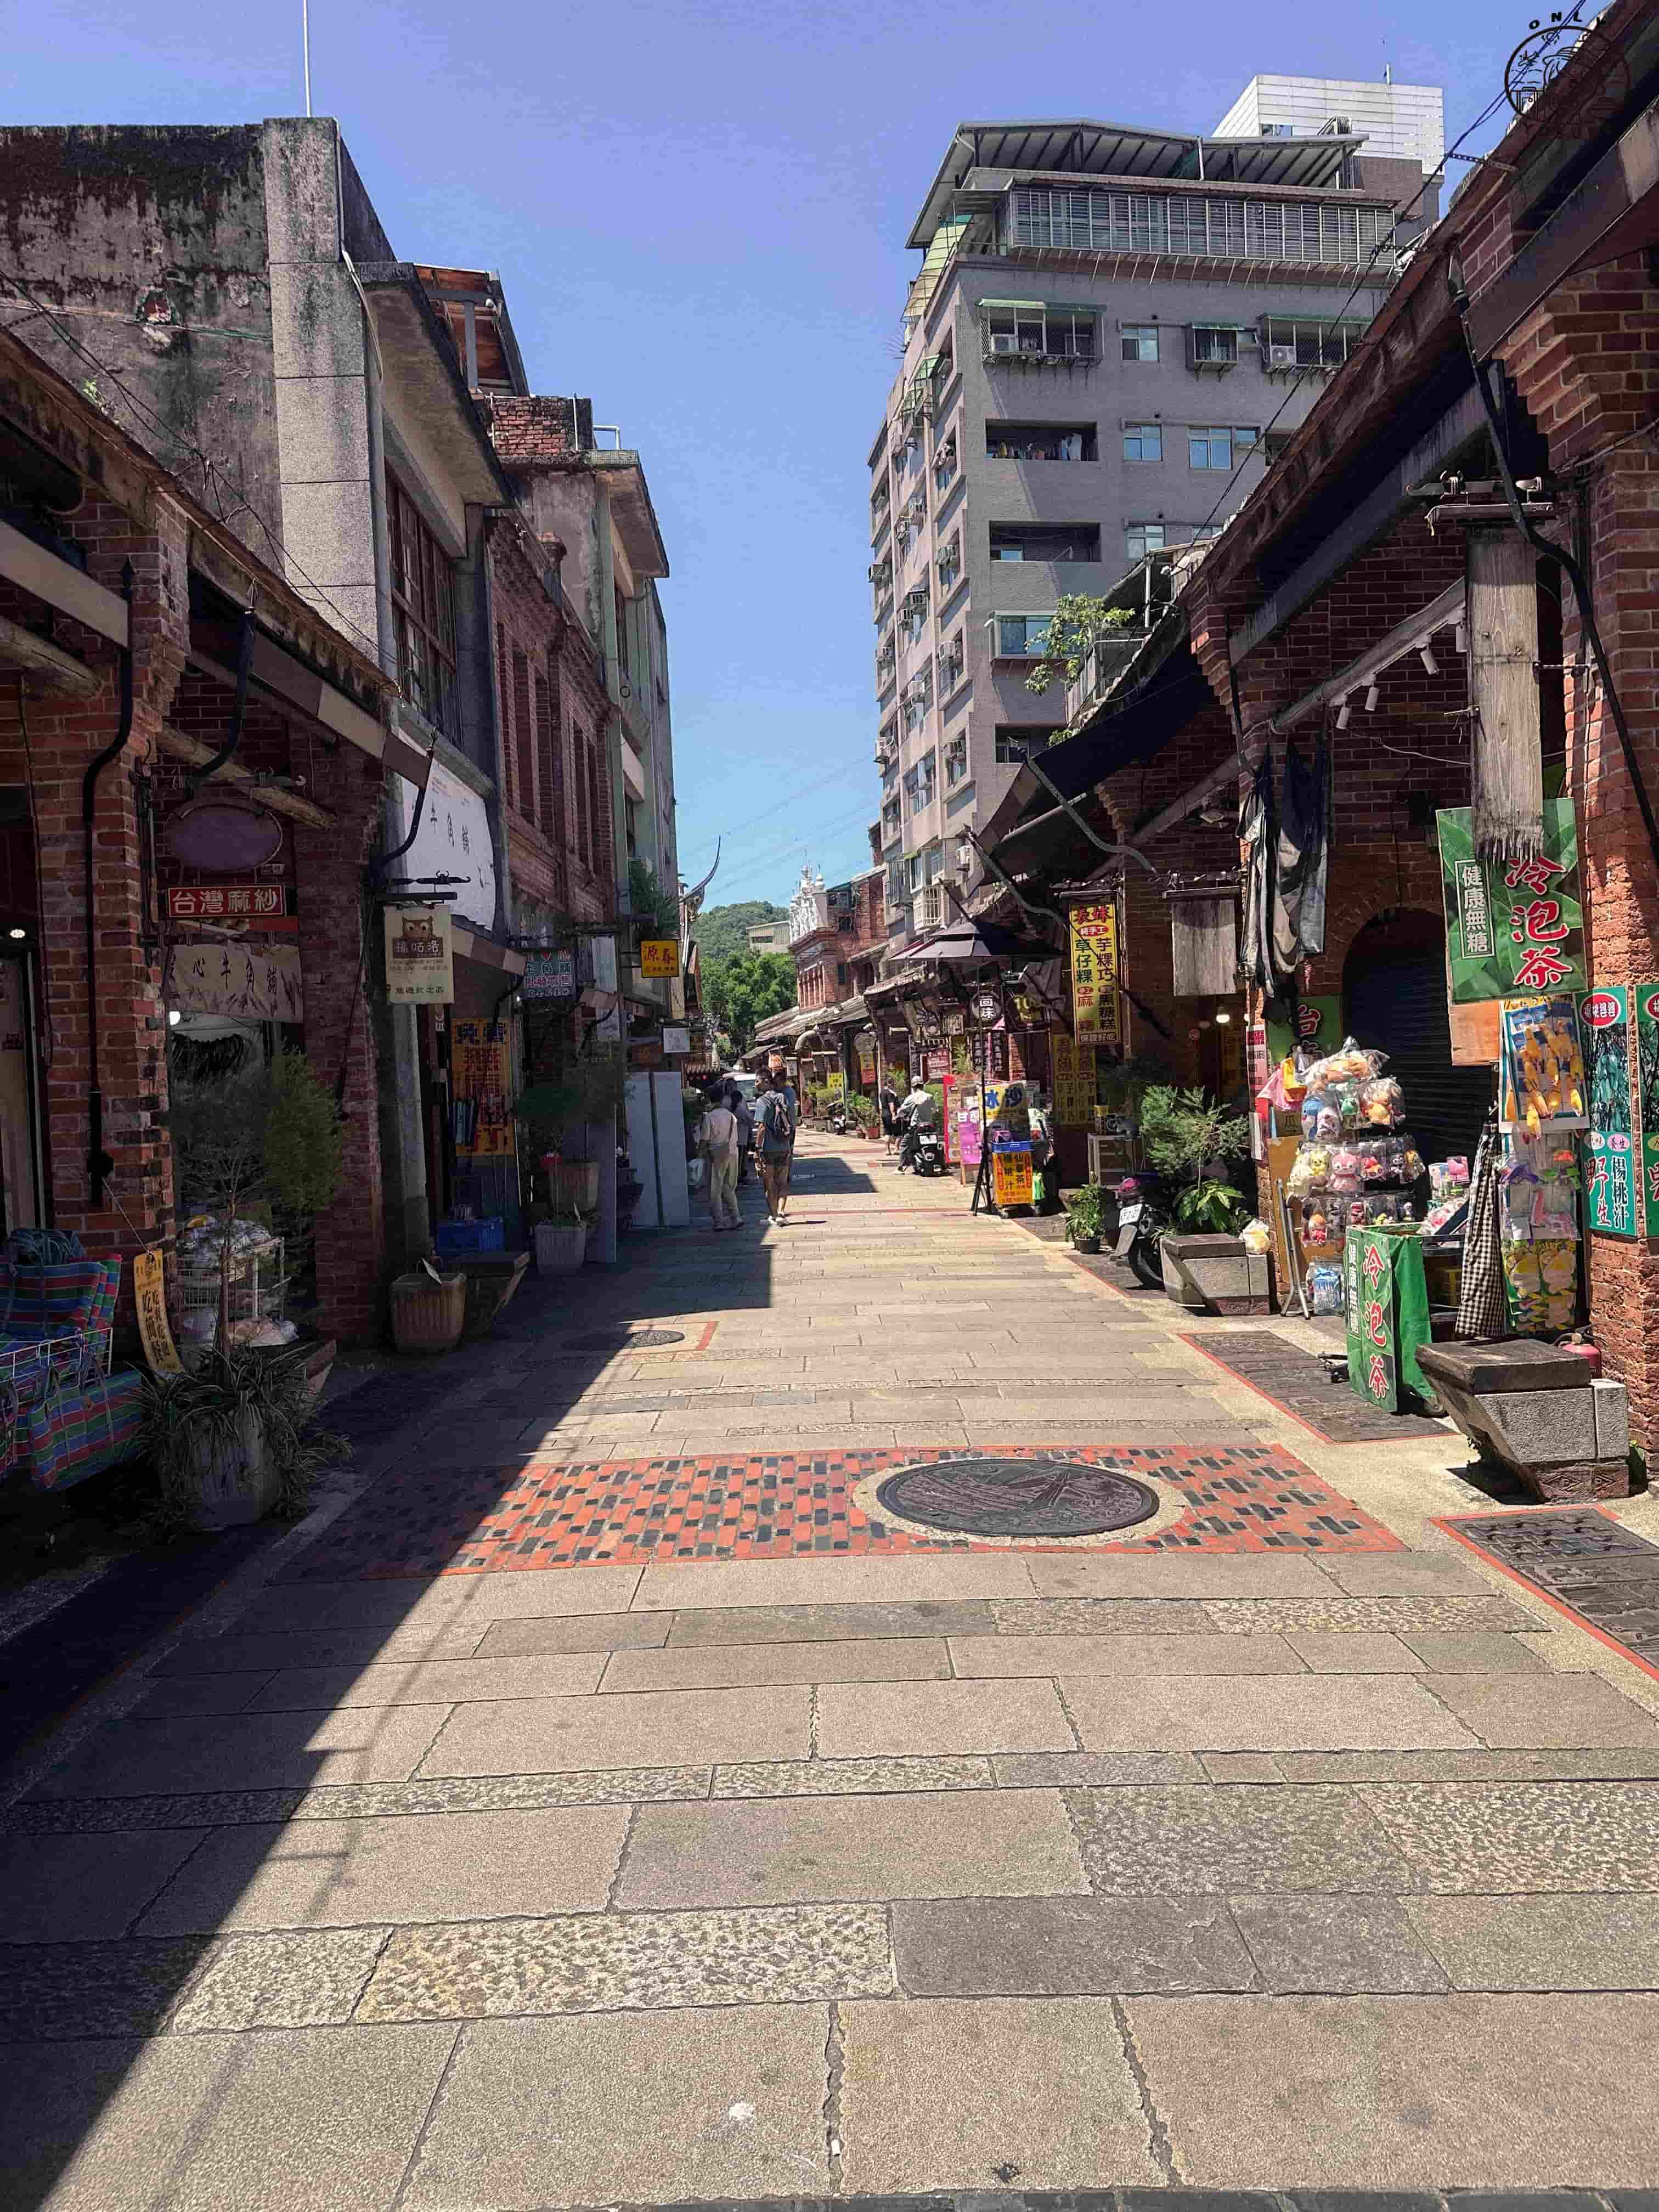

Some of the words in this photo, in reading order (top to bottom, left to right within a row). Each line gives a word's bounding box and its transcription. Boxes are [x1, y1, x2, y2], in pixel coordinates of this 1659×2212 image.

[171, 888, 278, 913] 台灣麻紗
[1462, 865, 1488, 954] 健康無糖
[1505, 855, 1573, 990] 冷泡茶
[1075, 938, 1093, 983] 草仔粿
[1096, 938, 1114, 982] 芋粿巧
[1584, 1155, 1611, 1227] 野生
[1611, 1156, 1629, 1229] 楊桃汁
[1362, 1243, 1389, 1399] 冷泡茶
